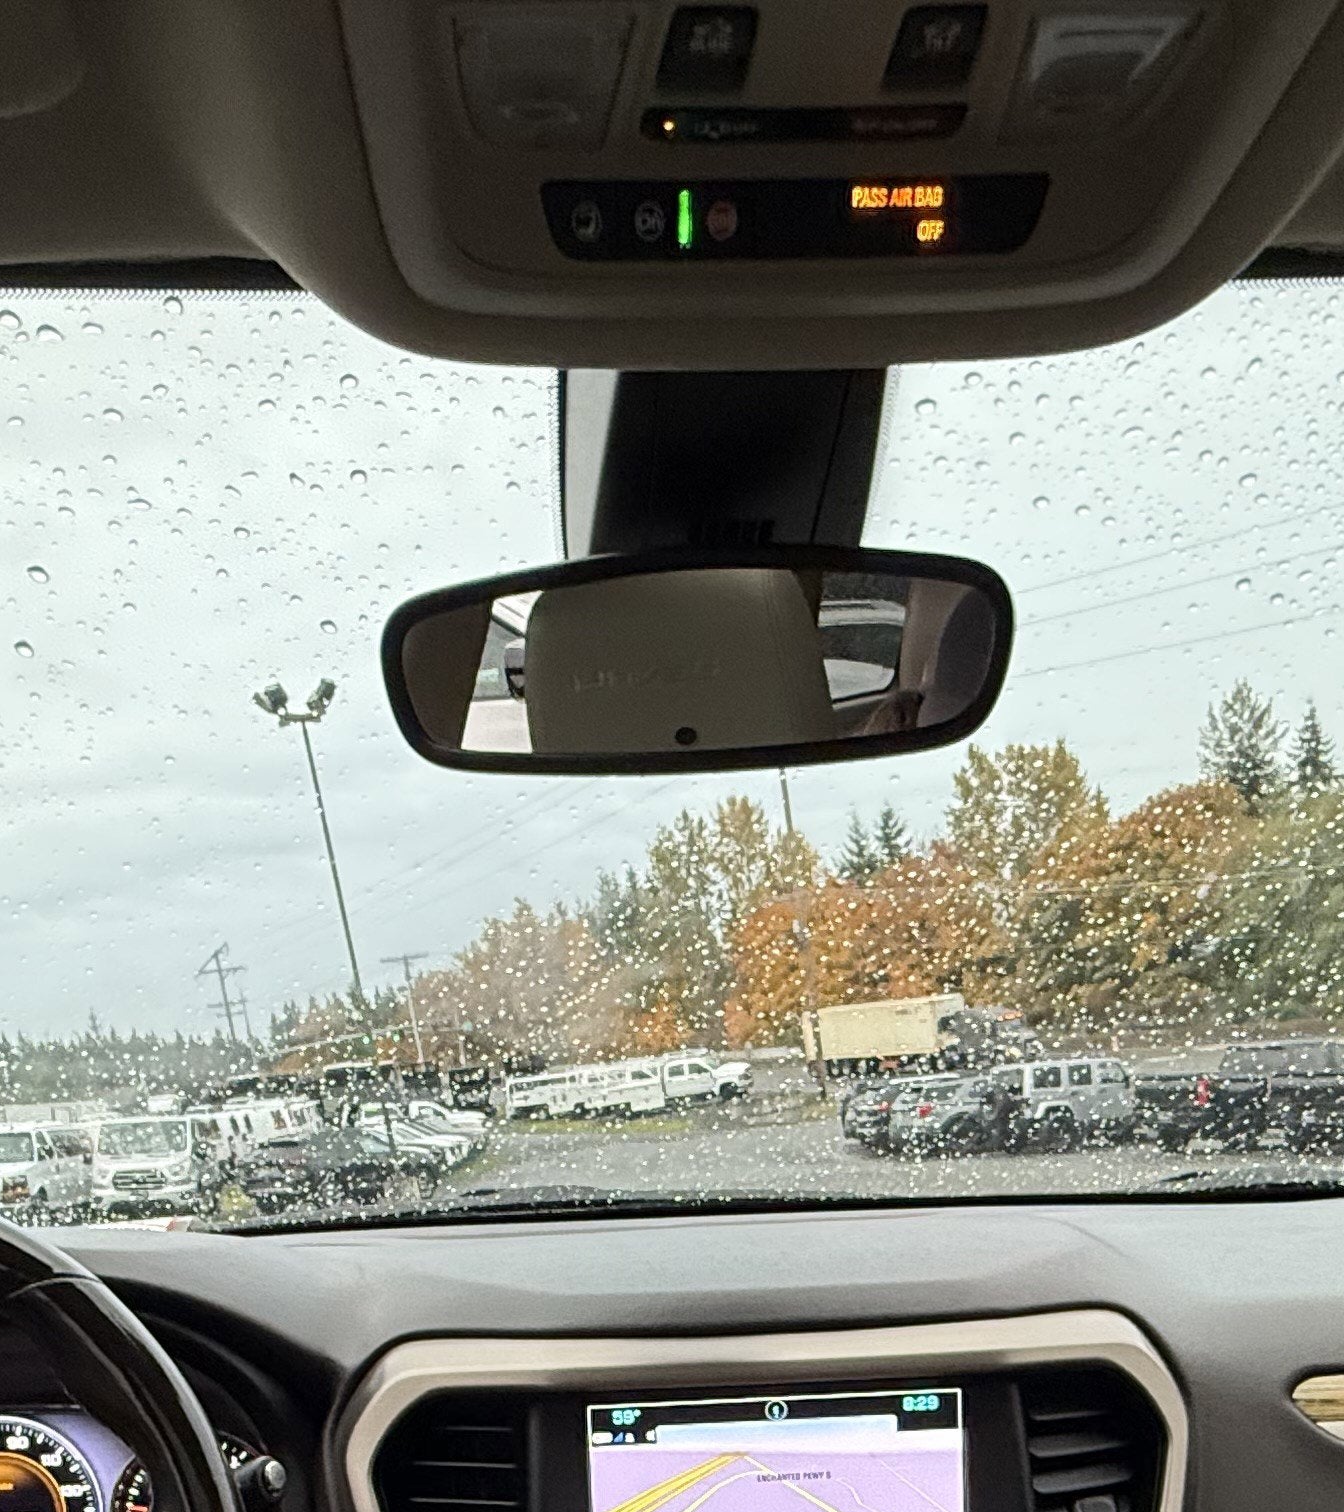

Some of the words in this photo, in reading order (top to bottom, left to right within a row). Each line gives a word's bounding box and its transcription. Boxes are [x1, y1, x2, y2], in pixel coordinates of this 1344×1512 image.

[851, 186, 888, 208] PASS
[889, 187, 913, 208] AIR
[914, 186, 944, 208] BAG
[917, 220, 945, 242] OFF
